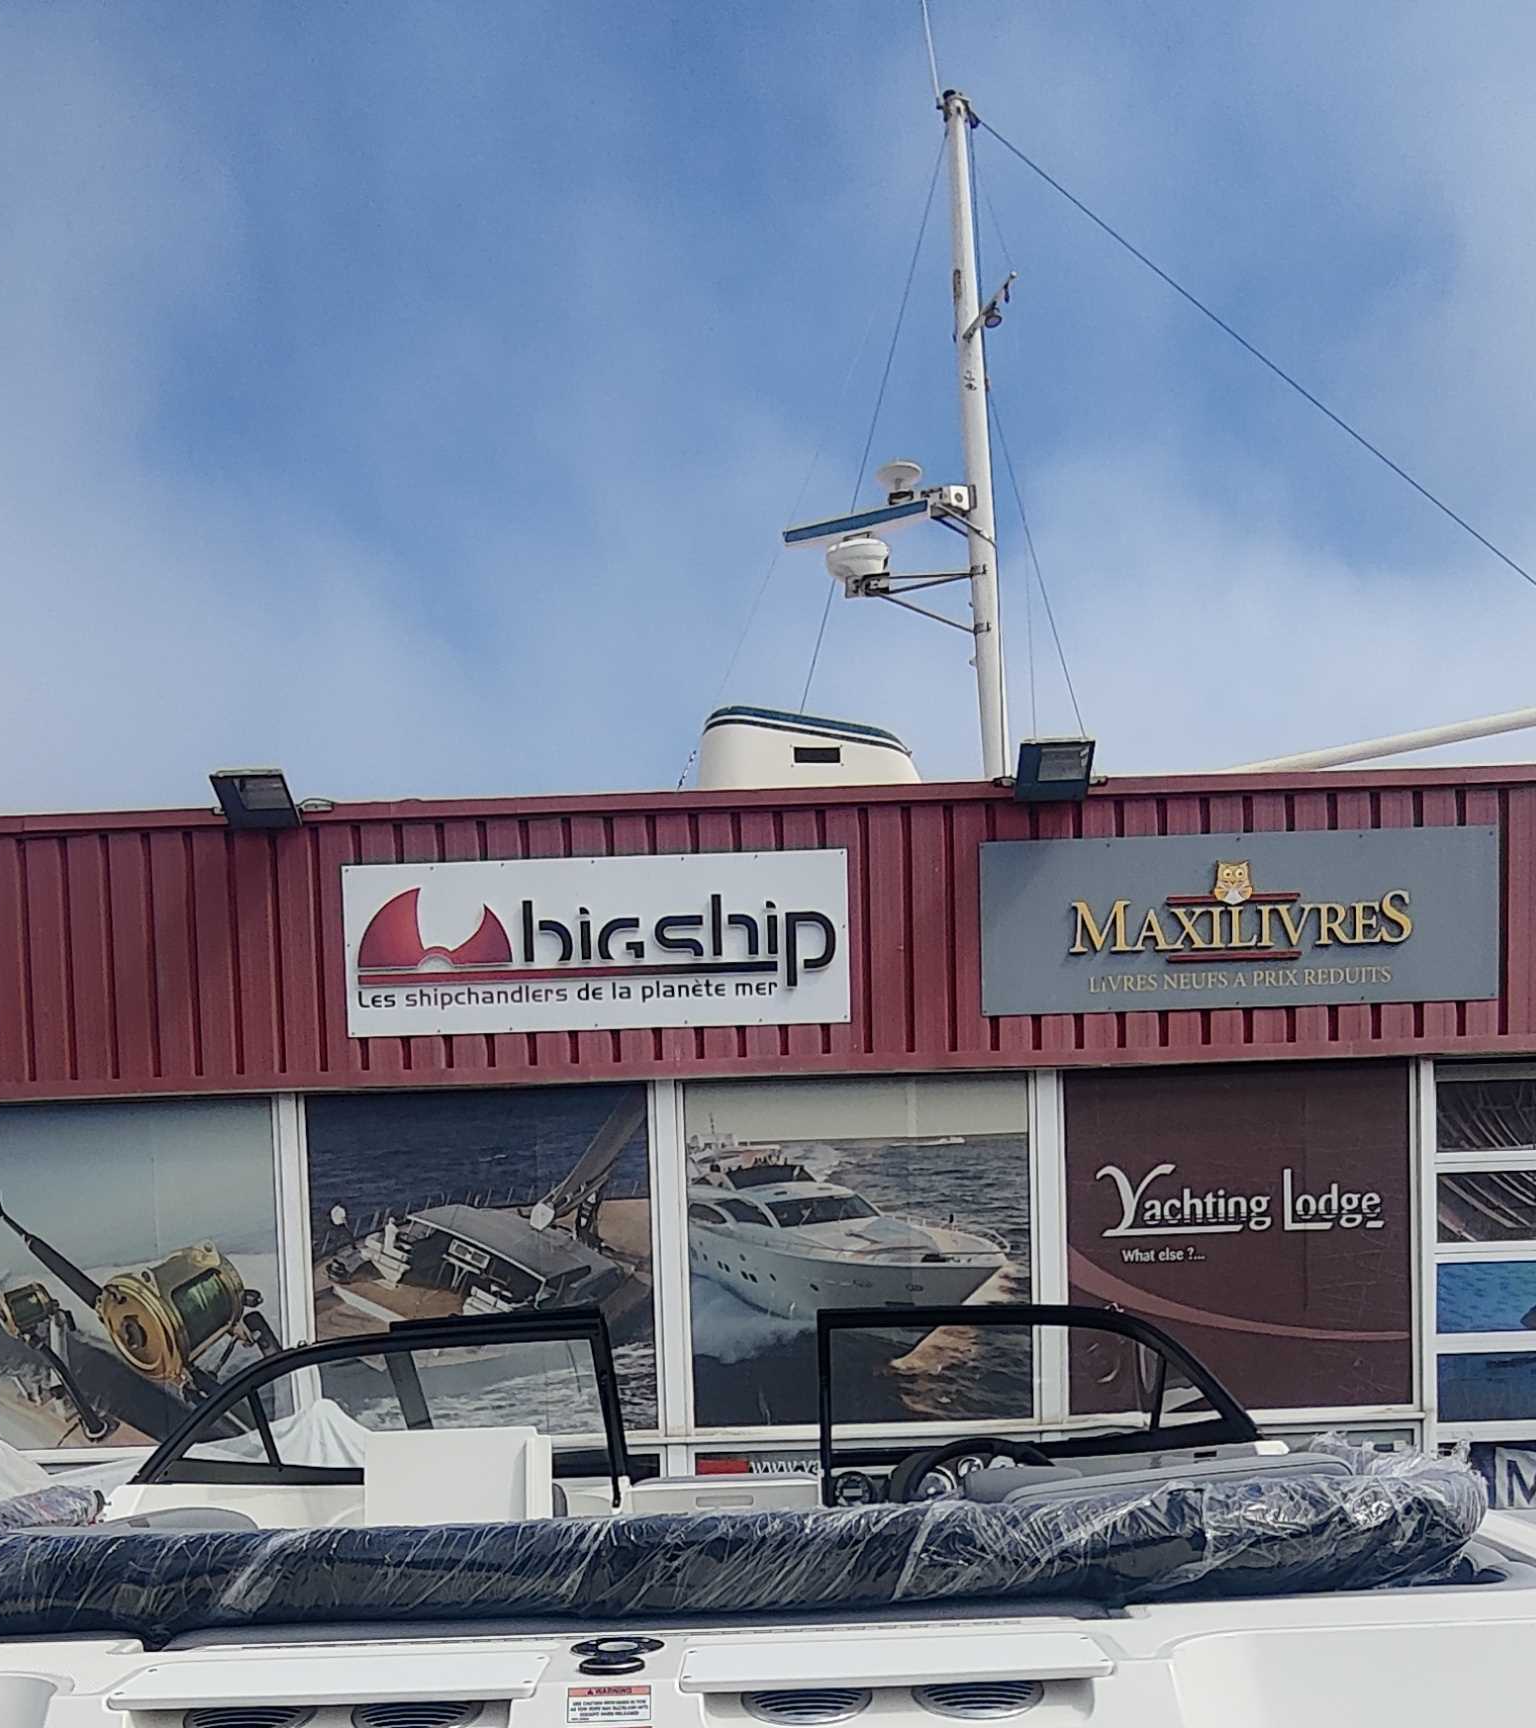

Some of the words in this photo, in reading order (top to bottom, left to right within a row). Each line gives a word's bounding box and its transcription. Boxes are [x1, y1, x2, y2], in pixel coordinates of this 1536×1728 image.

[1068, 888, 1413, 955] MAXILIVRES
[358, 990, 397, 1010] Les
[405, 983, 568, 1011] shipchandlers
[576, 983, 604, 1001] de
[612, 981, 632, 1000] la
[640, 977, 727, 1004] planète
[734, 980, 779, 998] mer
[1164, 970, 1228, 990] NEUFS
[1252, 968, 1300, 987] PRIX
[1303, 965, 1391, 986] REDUITS
[1095, 1164, 1272, 1238] Yachting
[1282, 1168, 1385, 1231] Lodge
[1122, 1248, 1156, 1263] What
[1158, 1248, 1185, 1262] else
